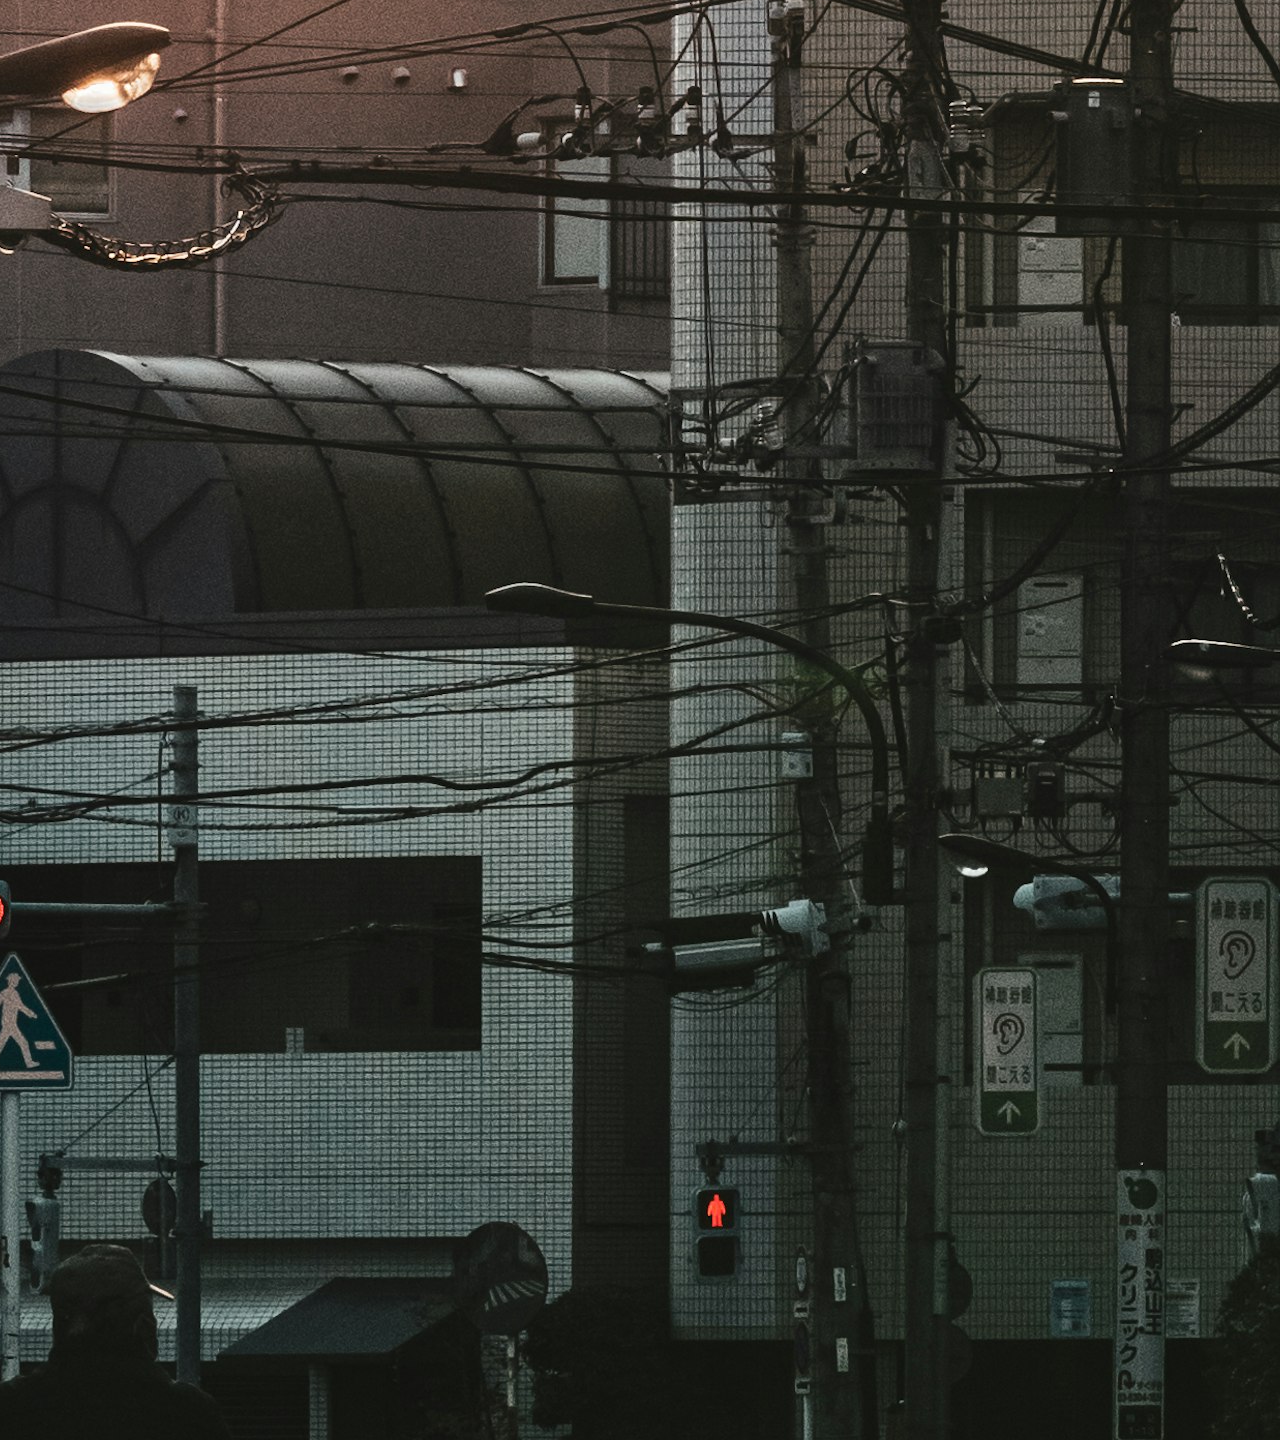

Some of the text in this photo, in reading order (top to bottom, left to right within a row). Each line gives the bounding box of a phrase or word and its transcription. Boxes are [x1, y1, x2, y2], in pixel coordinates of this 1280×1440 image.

[1120, 1263, 1138, 1365] クリニック
